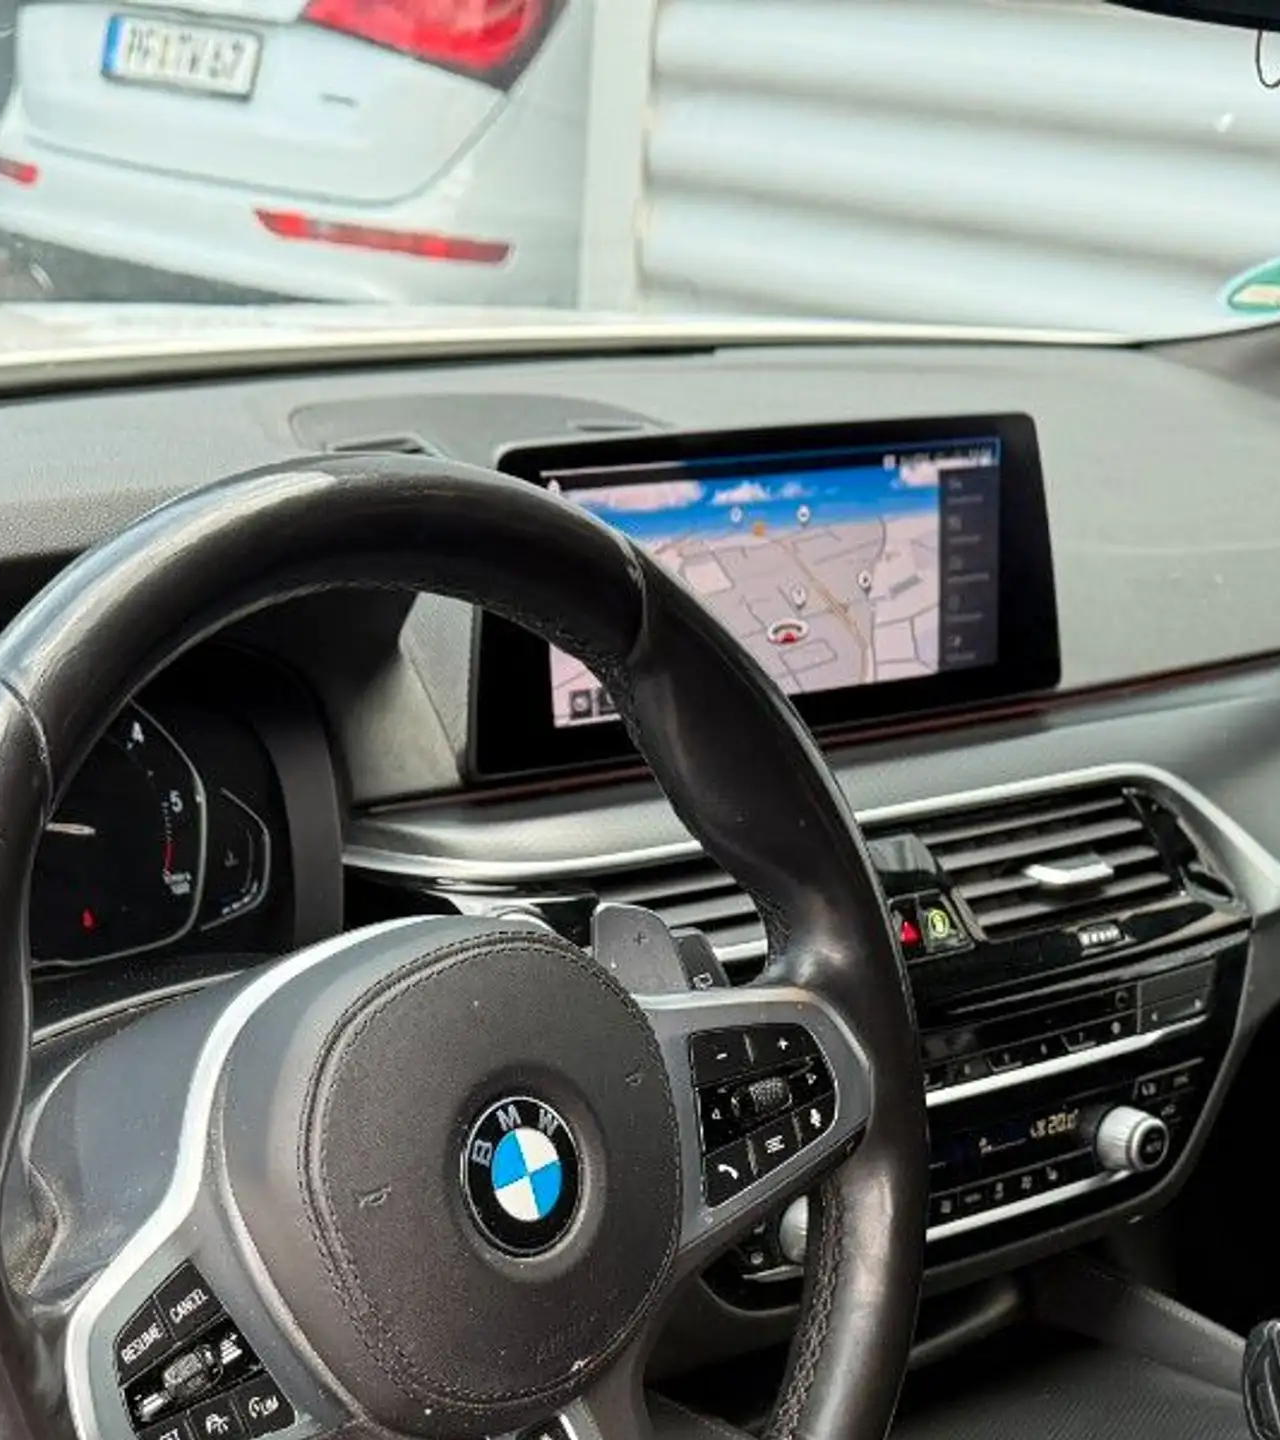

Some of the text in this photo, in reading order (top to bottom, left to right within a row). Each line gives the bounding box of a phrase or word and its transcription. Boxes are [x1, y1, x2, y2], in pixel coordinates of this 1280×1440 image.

[131, 722, 144, 743] 4
[170, 790, 183, 813] 5
[472, 1103, 560, 1168] BMW
[169, 1287, 209, 1324] CANCEL
[120, 1321, 163, 1365] RESUME
